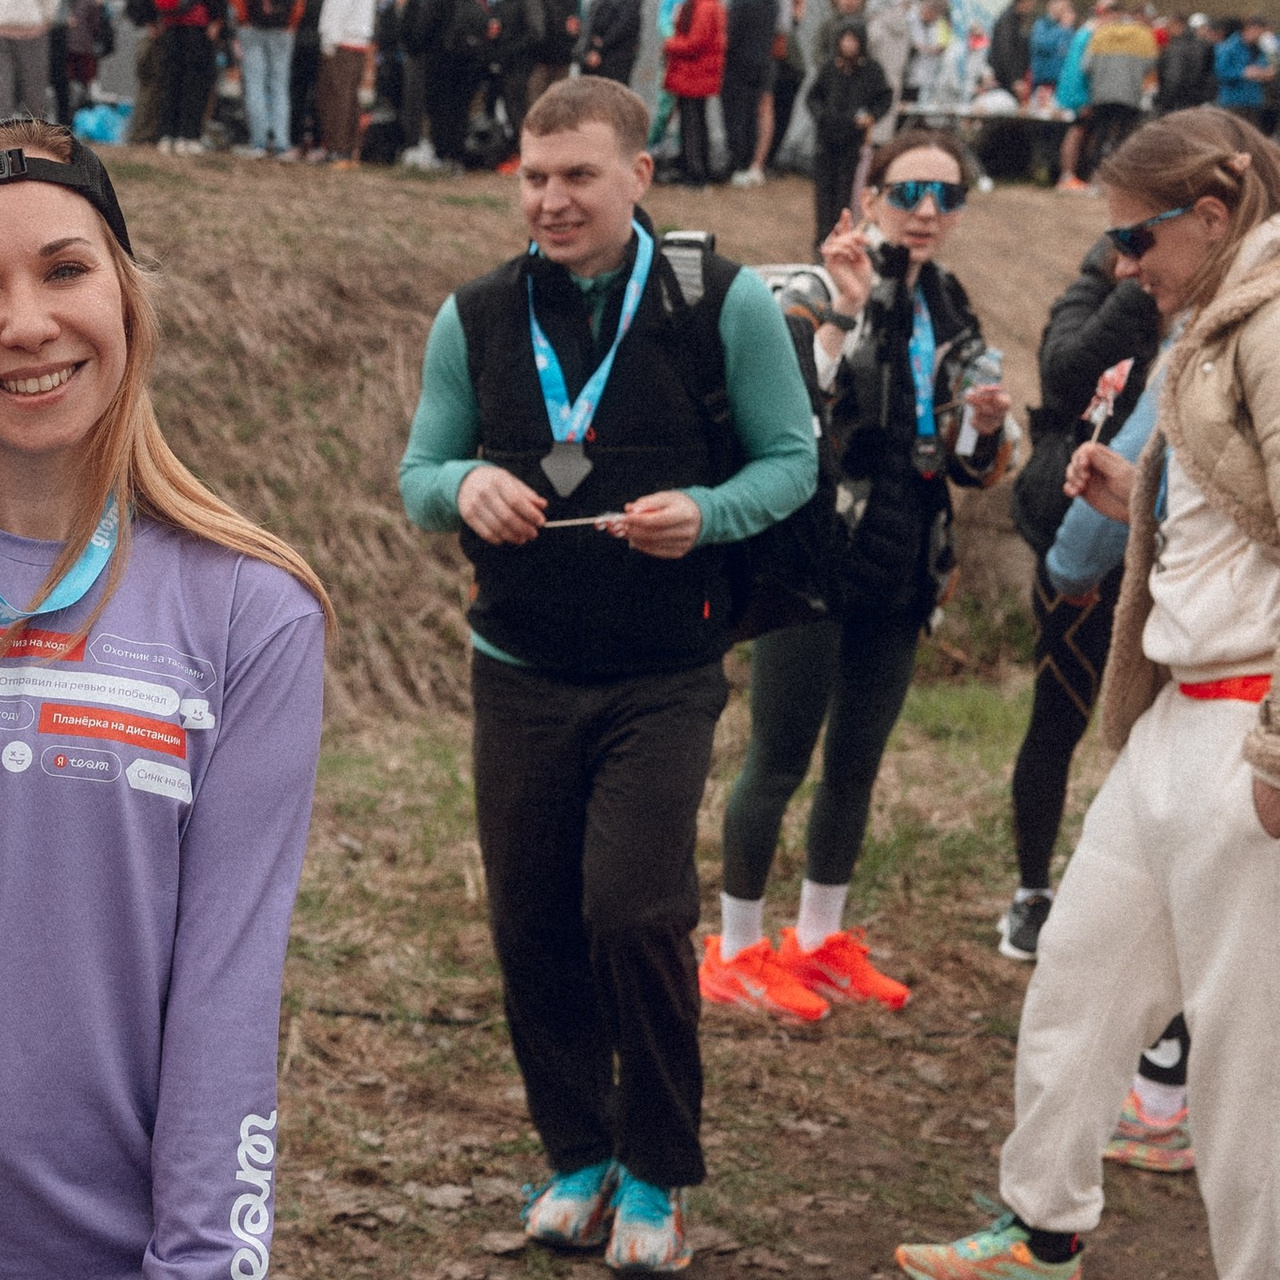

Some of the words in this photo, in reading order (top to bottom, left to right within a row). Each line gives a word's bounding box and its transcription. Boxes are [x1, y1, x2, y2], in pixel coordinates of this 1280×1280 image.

[29, 638, 43, 648] на
[102, 643, 150, 662] Охотник
[152, 654, 165, 663] за
[54, 680, 67, 689] на
[69, 681, 106, 693] ревью
[108, 686, 116, 694] и
[118, 686, 167, 706] побежал
[52, 713, 109, 730] Планёрка
[111, 721, 125, 731] на
[126, 725, 181, 746] дистанции
[68, 757, 109, 771] team
[137, 768, 164, 782] Синк
[165, 775, 177, 787] на
